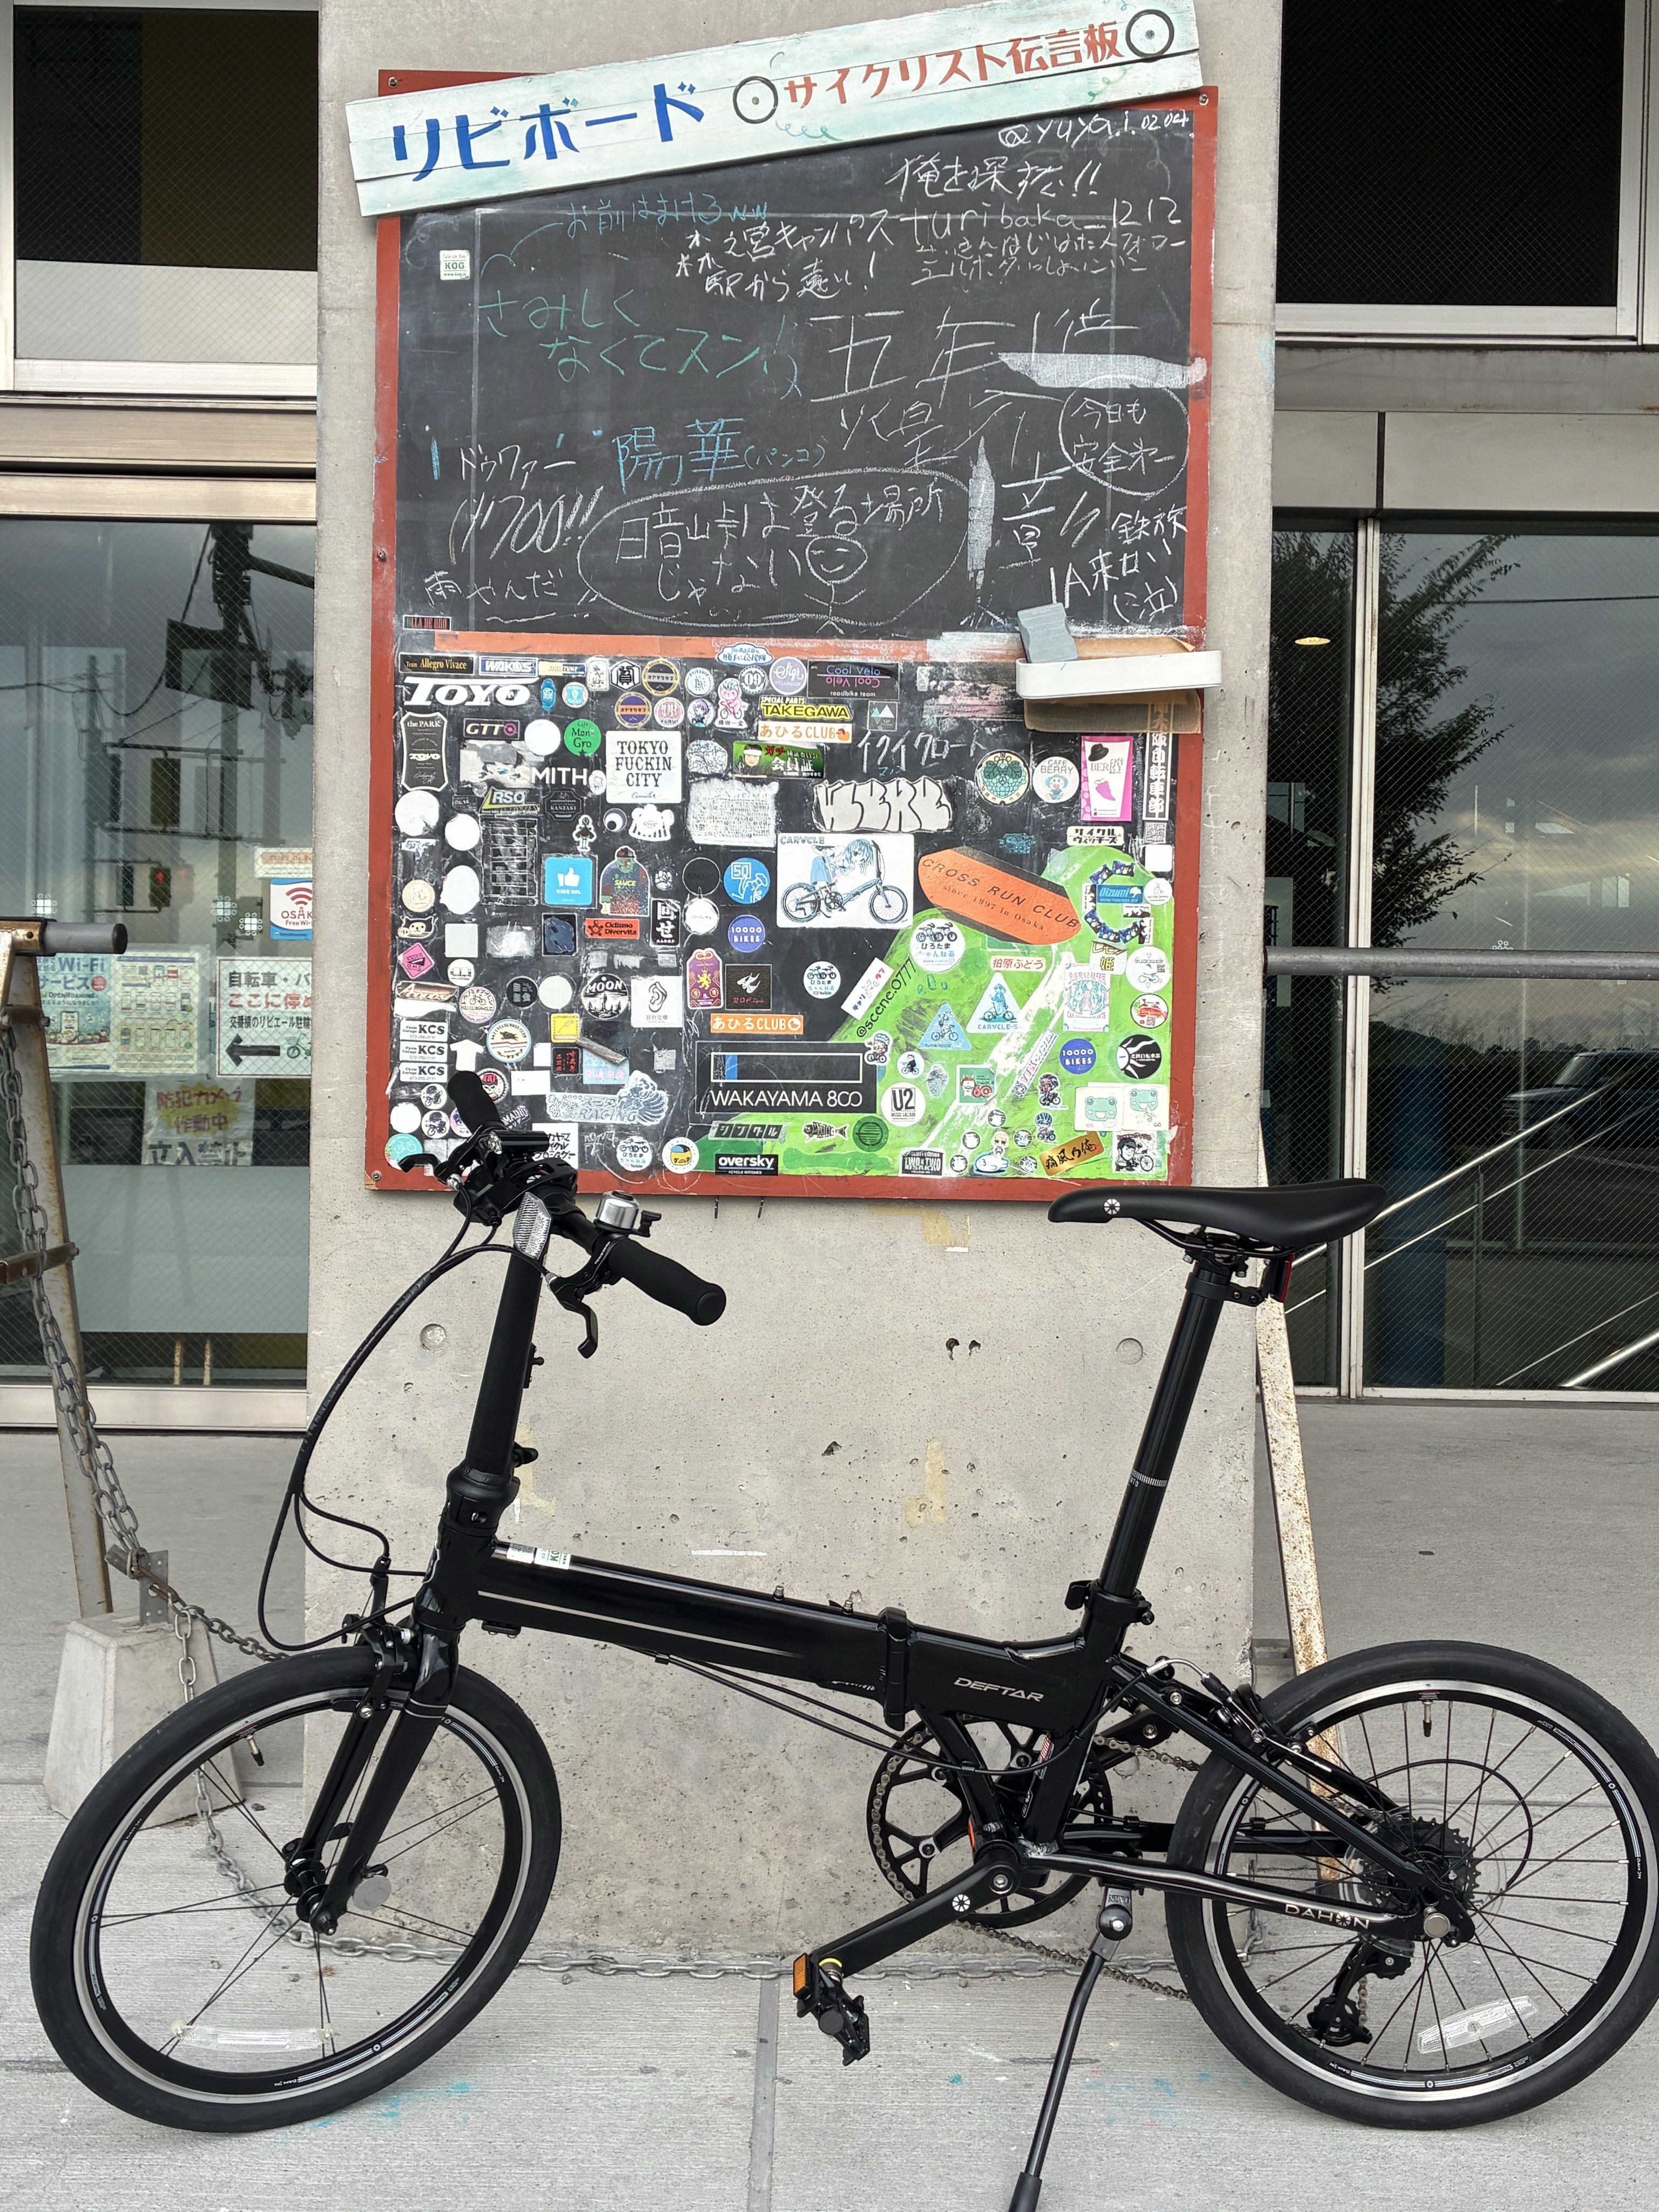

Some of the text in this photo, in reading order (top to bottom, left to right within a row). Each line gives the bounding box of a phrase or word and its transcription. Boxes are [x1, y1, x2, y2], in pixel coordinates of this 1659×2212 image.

[784, 21, 1123, 108] サイクリスト伝言板
[393, 82, 704, 182] リビボード
[826, 665, 881, 676] Cool Velo
[763, 704, 849, 718] TAKEGAWA
[573, 737, 592, 748] Gro
[617, 740, 669, 755] TOKYO
[615, 756, 672, 771] FUCKIN
[625, 772, 662, 787] CITY
[922, 859, 1080, 928] CROSS RUN CLUB
[733, 934, 760, 943] BIKES
[58, 957, 105, 972] Wi-Fi
[992, 958, 1044, 970] 柏原ぶどう
[587, 979, 622, 993] MOON
[418, 1024, 445, 1035] KCS
[712, 1016, 786, 1031] あひるCLUB
[417, 1044, 445, 1055] KCS
[1064, 1057, 1092, 1066] BIKES
[417, 1065, 445, 1076] KCS
[710, 1090, 824, 1107] WAKAYAMA
[148, 1140, 247, 1166] 立入禁止
[718, 1155, 775, 1169] oversky
[953, 1676, 1044, 1703] DEFTAR
